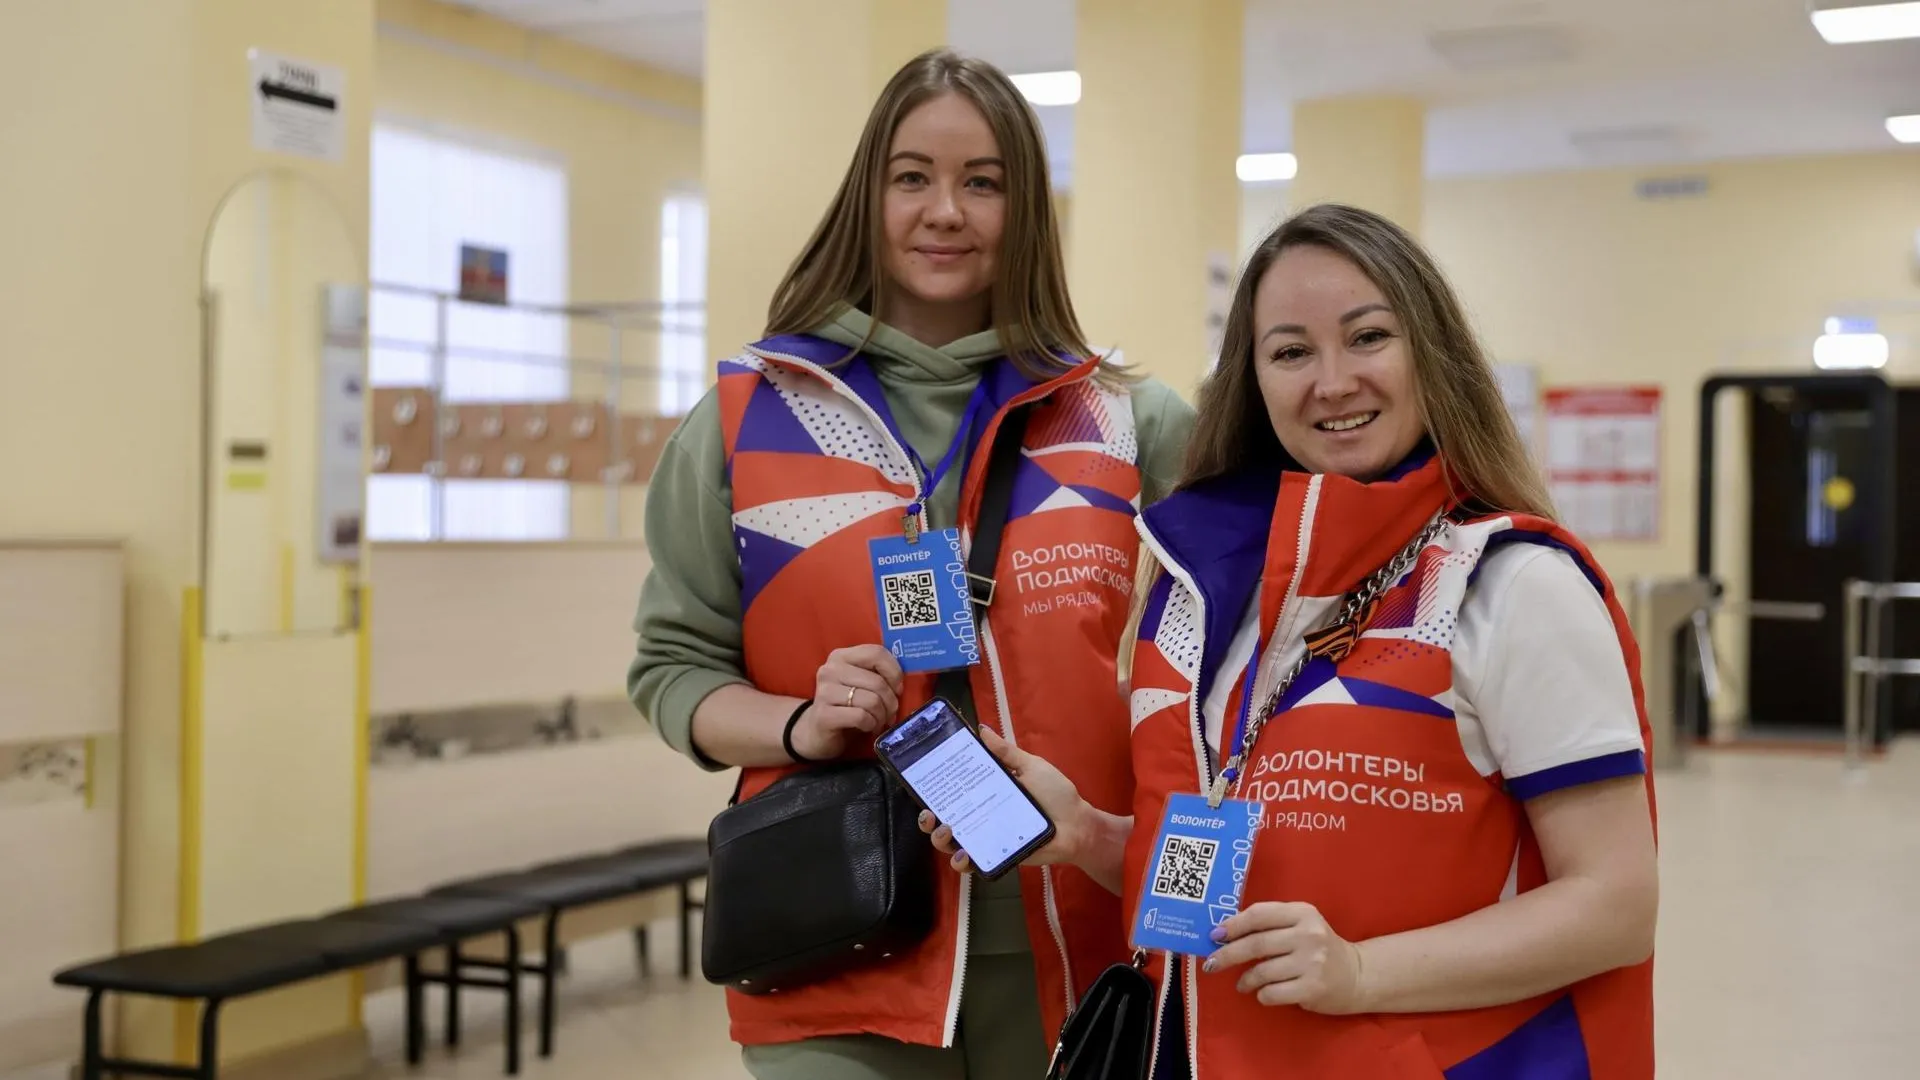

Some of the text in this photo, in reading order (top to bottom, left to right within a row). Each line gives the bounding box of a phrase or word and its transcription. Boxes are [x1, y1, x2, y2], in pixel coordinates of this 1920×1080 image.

[1023, 598, 1052, 616] МЫ
[1253, 750, 1424, 783] ВОЛОНТЕРЫ
[1246, 779, 1463, 813] ПОДМОСКОВЬЯ
[1170, 814, 1226, 829] ВОЛОНТЁР
[1257, 811, 1346, 831] Ы РЯДОМ
